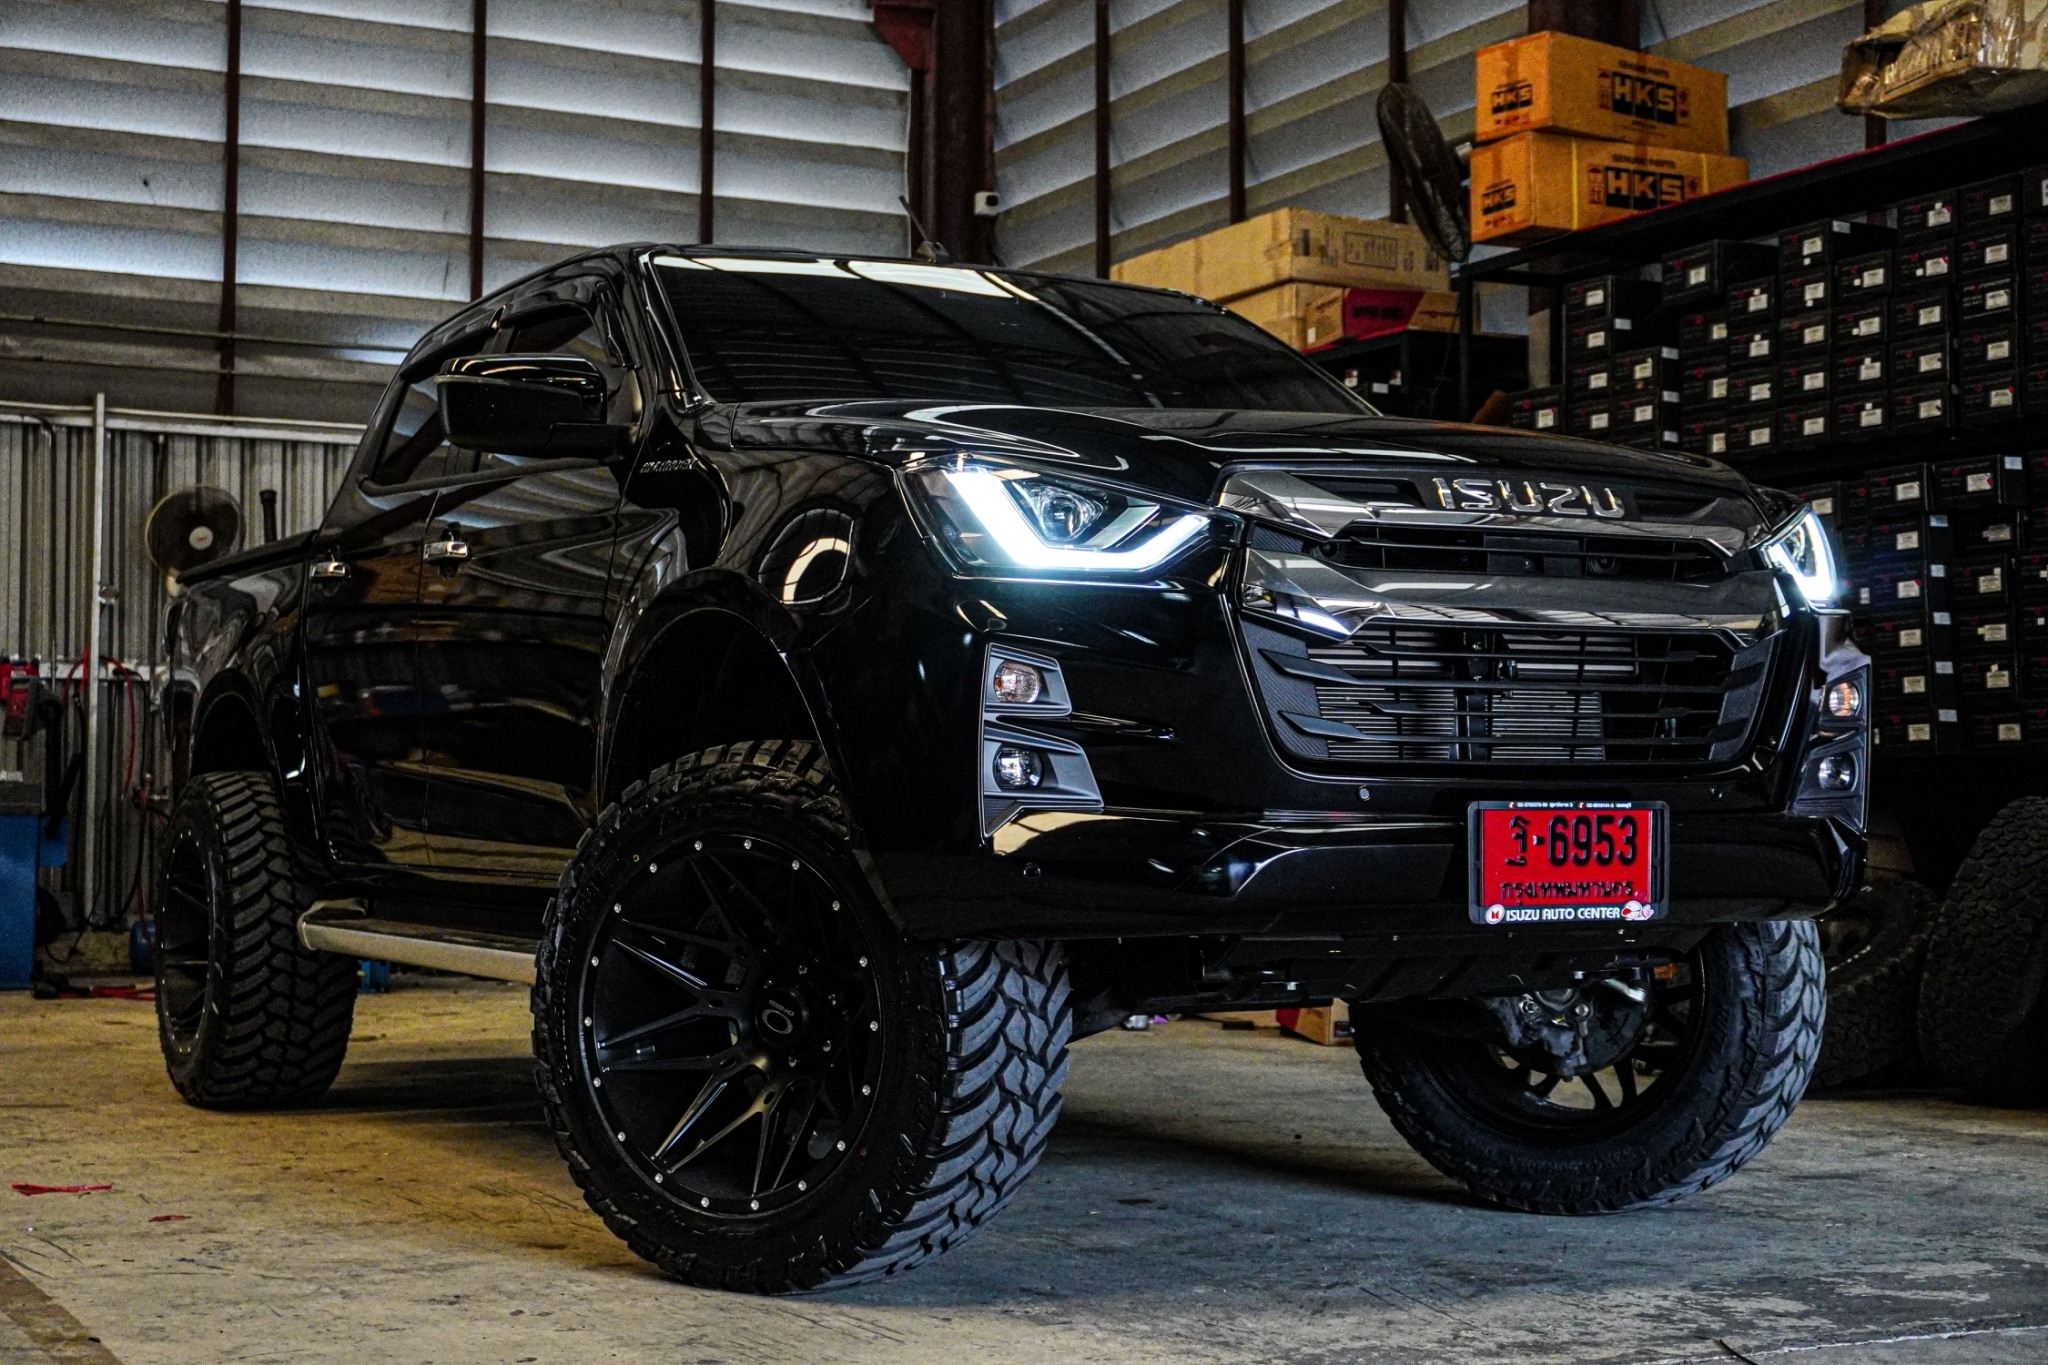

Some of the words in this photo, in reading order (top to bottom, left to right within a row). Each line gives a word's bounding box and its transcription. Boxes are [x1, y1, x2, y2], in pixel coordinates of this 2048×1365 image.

[1493, 86, 1531, 109] HKS
[1614, 75, 1676, 114] HKS
[1484, 188, 1514, 210] HKS
[1607, 170, 1683, 202] HKS
[1432, 477, 1625, 518] ISUZU
[1506, 909, 1540, 922] ISUZU
[1542, 908, 1575, 920] AUTO
[1577, 907, 1621, 919] CENTER
